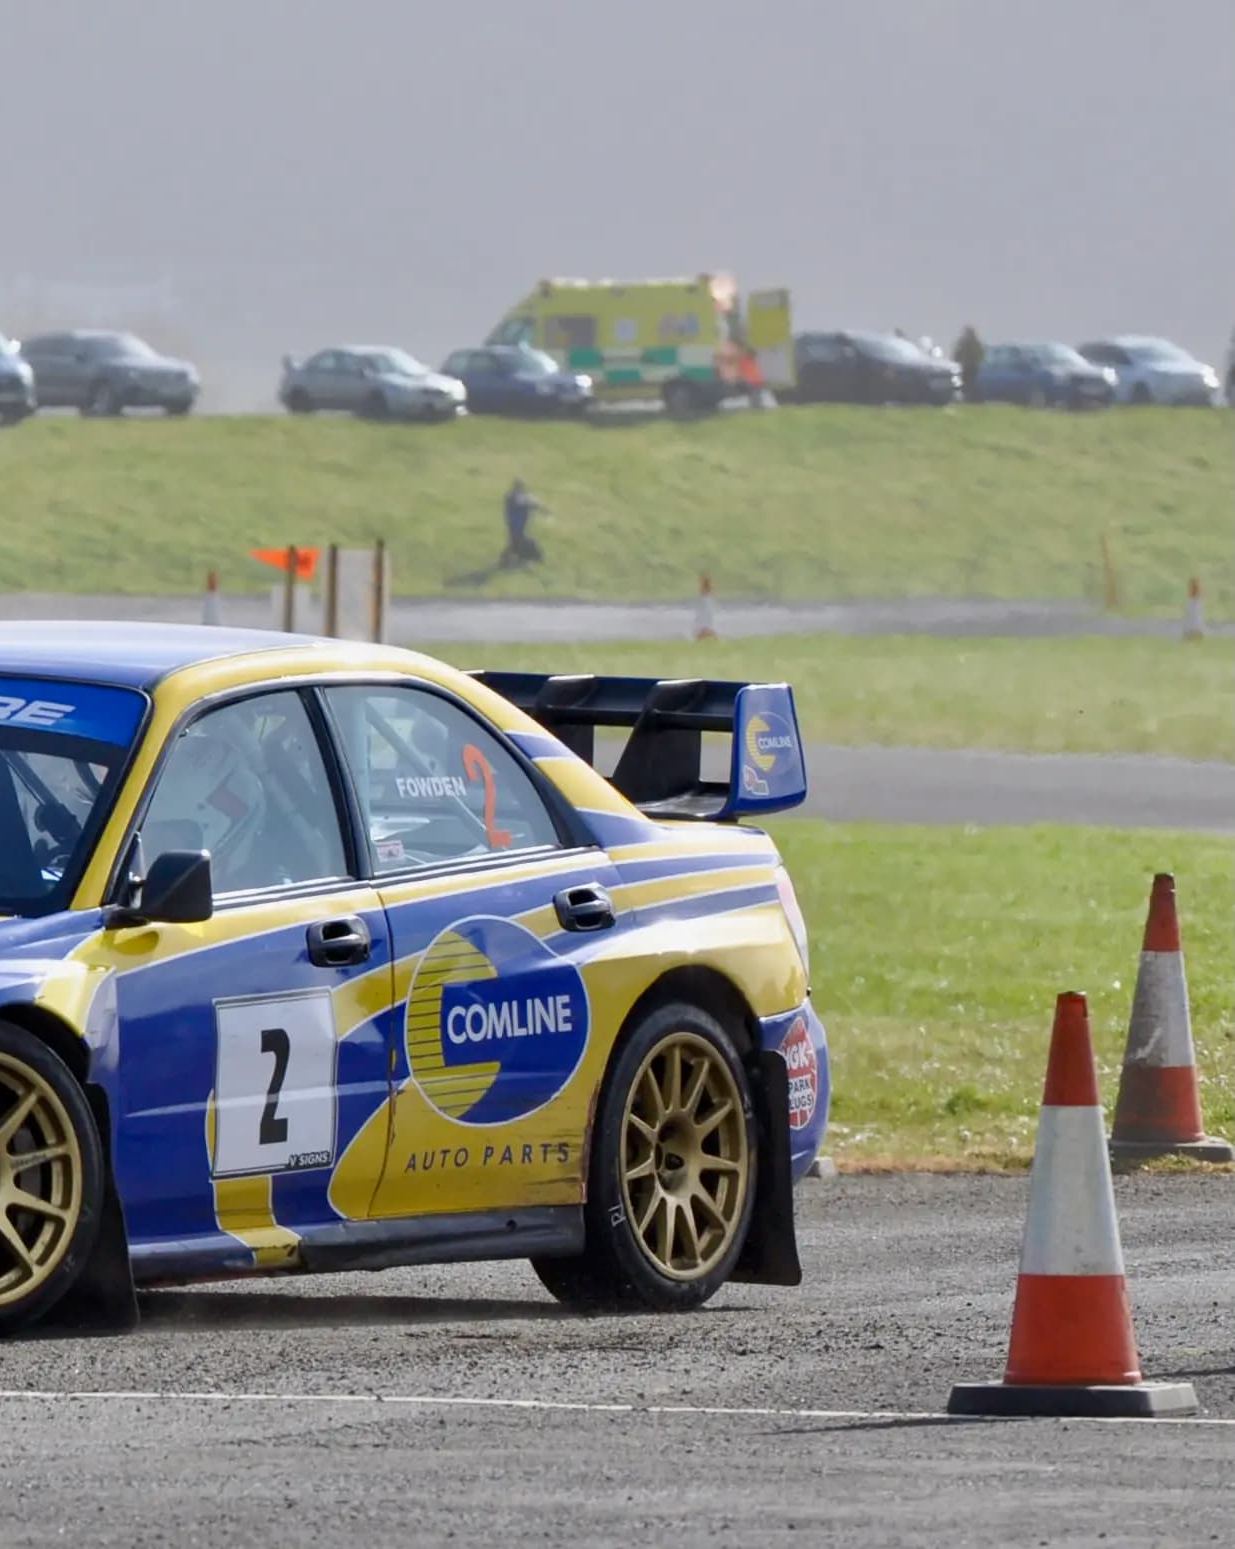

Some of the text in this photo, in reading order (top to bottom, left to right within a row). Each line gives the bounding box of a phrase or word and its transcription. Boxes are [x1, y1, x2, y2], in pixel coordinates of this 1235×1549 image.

[758, 736, 792, 750] COMLINE
[396, 776, 467, 799] FOWDEN
[462, 743, 513, 848] 2
[447, 994, 573, 1044] COMLINE
[259, 1028, 291, 1145] 2
[788, 1079, 811, 1094] PARK
[789, 1095, 813, 1110] LUGS
[299, 1151, 328, 1166] SIGNS
[404, 1142, 569, 1174] AUTO PARTS
